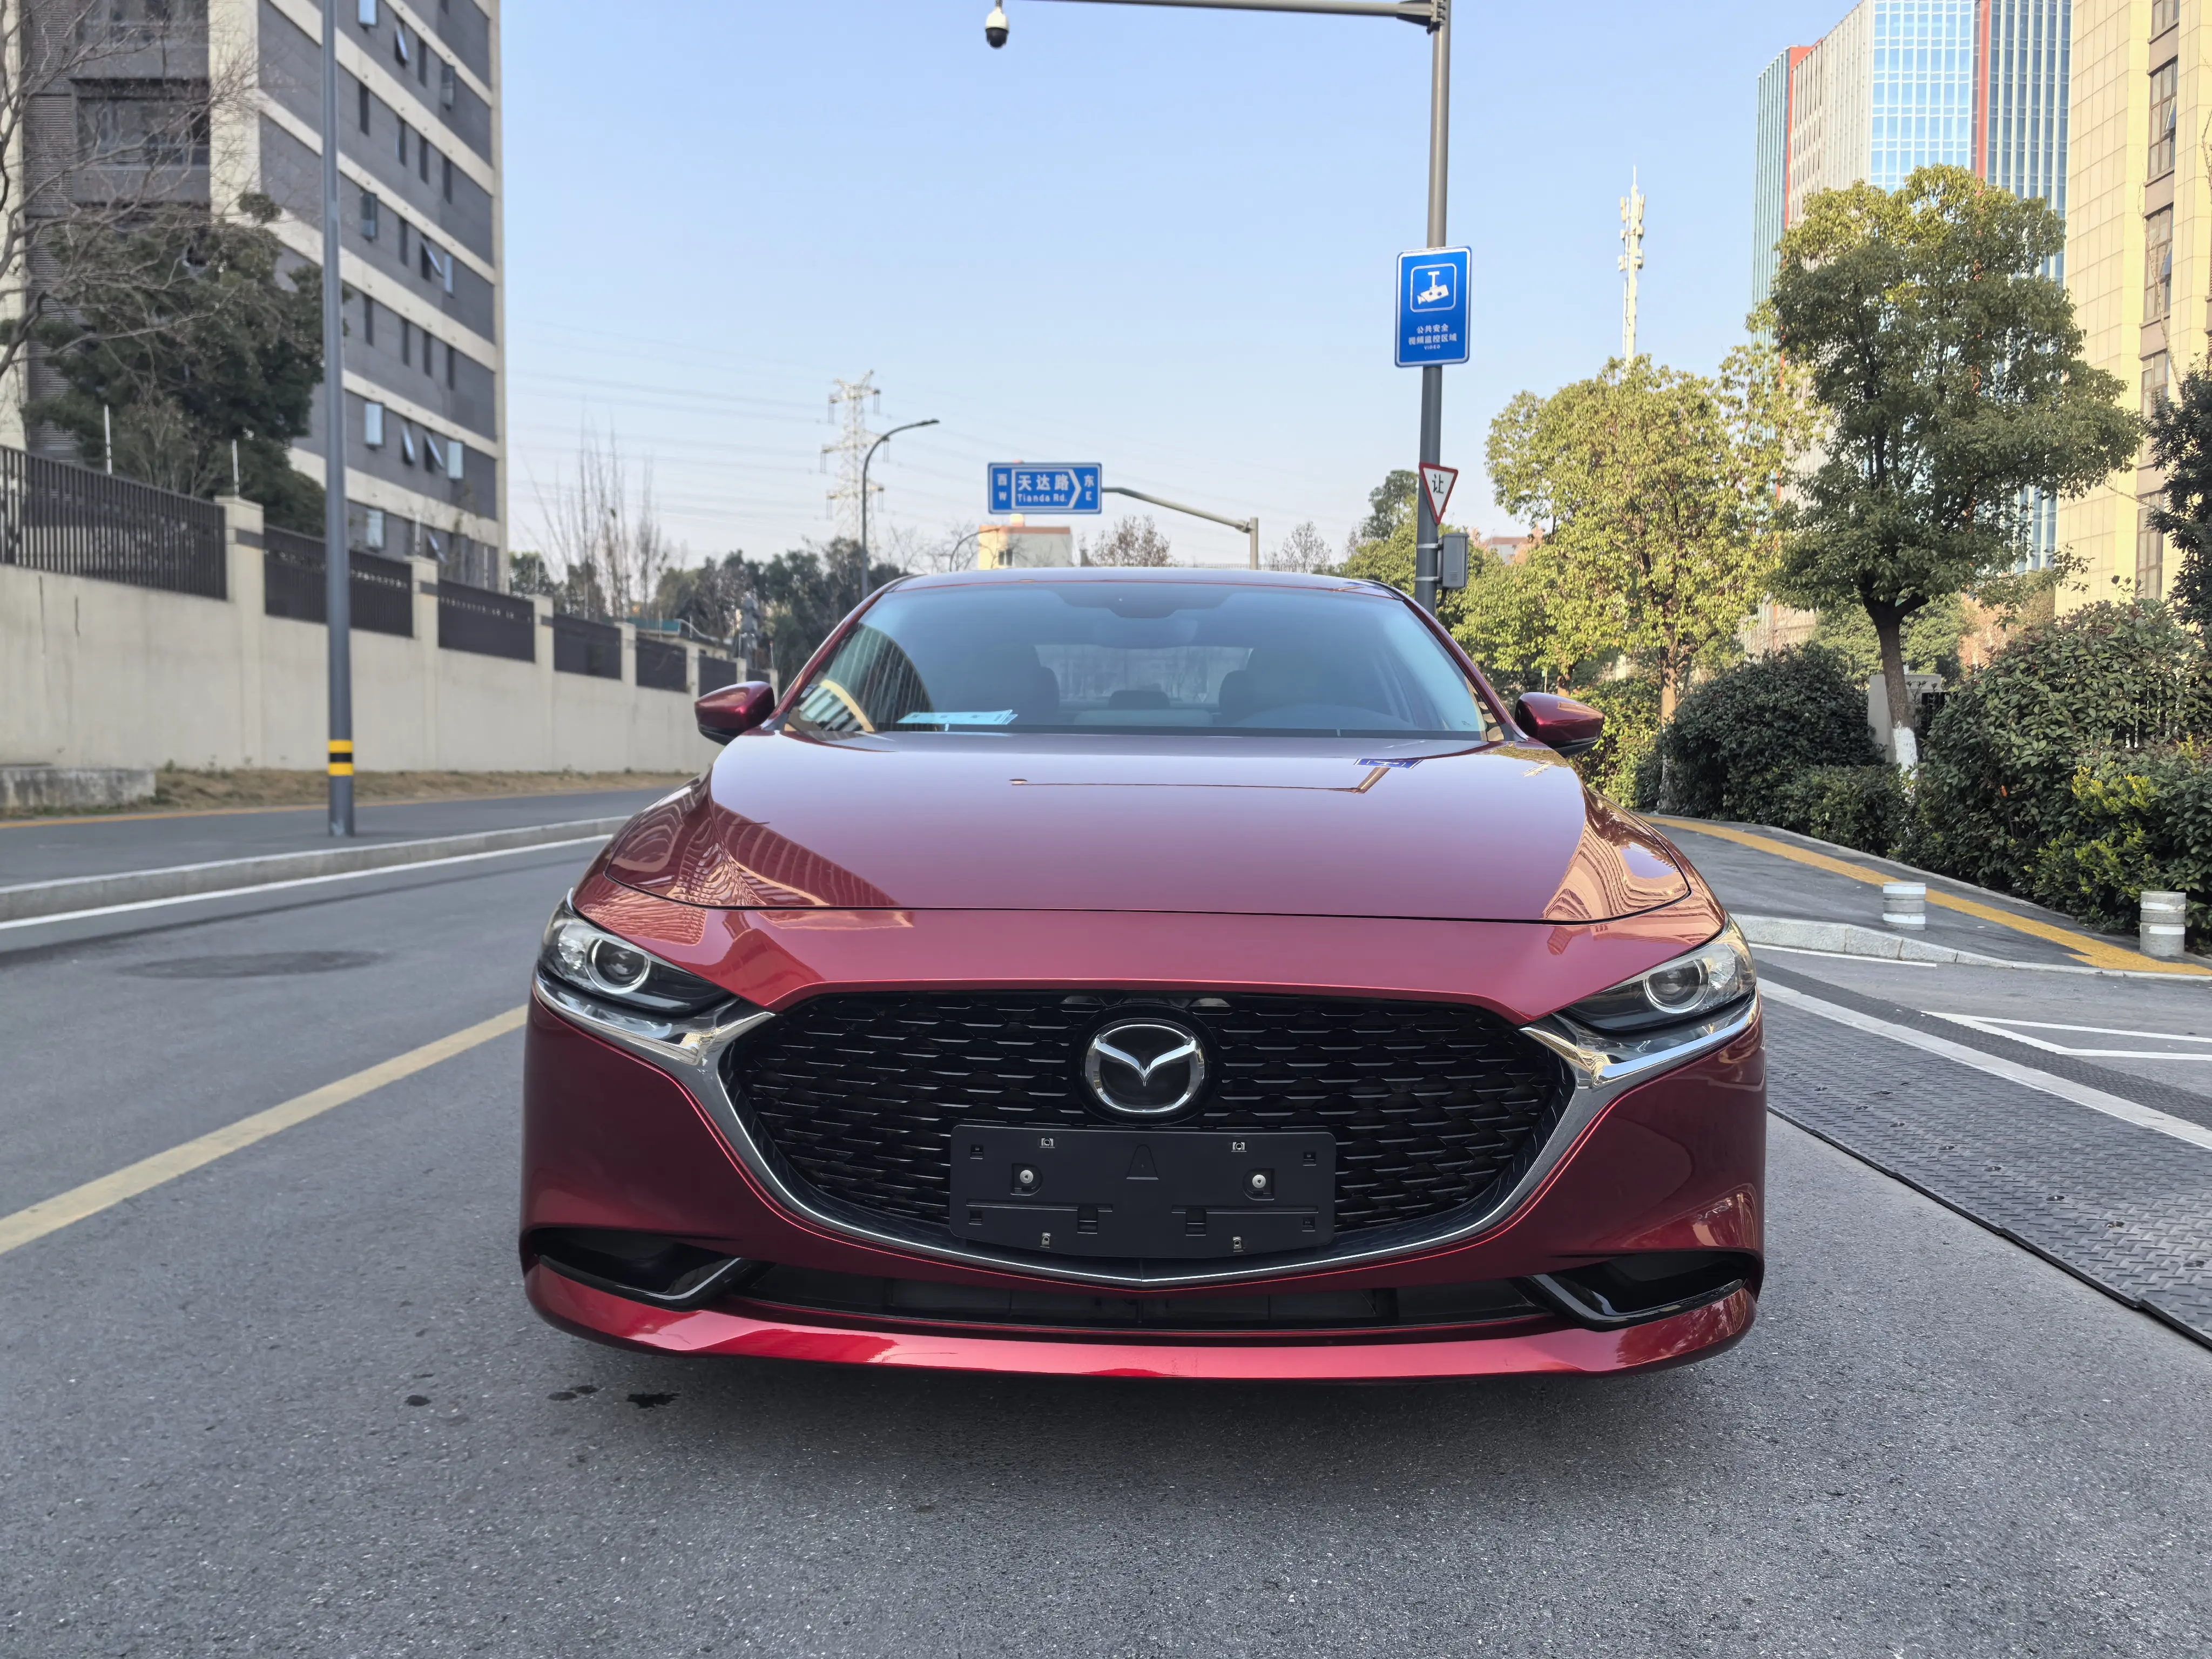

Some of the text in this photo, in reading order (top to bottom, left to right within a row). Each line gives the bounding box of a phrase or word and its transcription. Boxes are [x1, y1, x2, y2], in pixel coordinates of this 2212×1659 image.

[1417, 323, 1448, 334] 公共安全
[1408, 333, 1457, 346] 视频监控区域
[997, 474, 1007, 486] 西
[1017, 474, 1069, 491] 天达路
[1084, 474, 1094, 487] 东
[1432, 473, 1444, 494] 让
[999, 491, 1007, 501] W
[1017, 493, 1067, 502] Tianda Rd.
[1085, 491, 1092, 501] E
